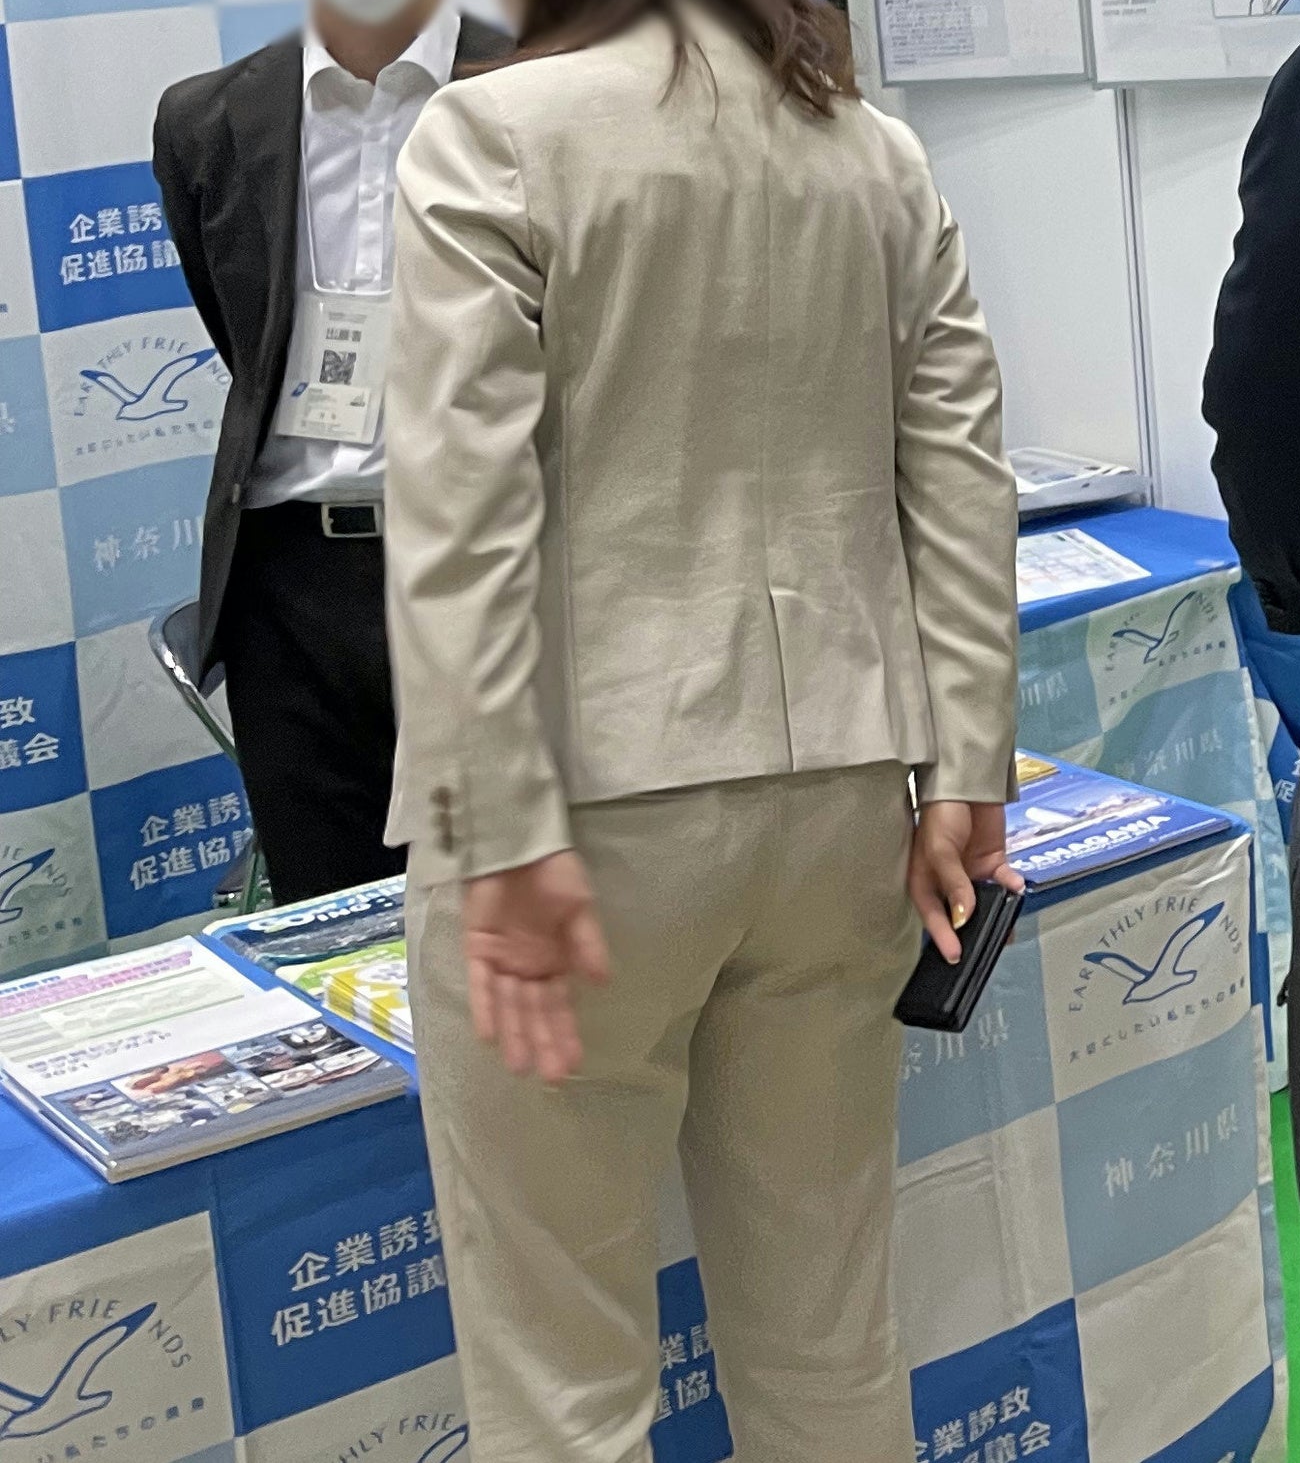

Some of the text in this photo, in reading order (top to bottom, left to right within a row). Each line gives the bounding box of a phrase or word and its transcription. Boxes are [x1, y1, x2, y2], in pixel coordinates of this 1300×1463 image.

[140, 791, 250, 848] 企業誘
[1103, 1114, 1239, 1199] 神奈川県
